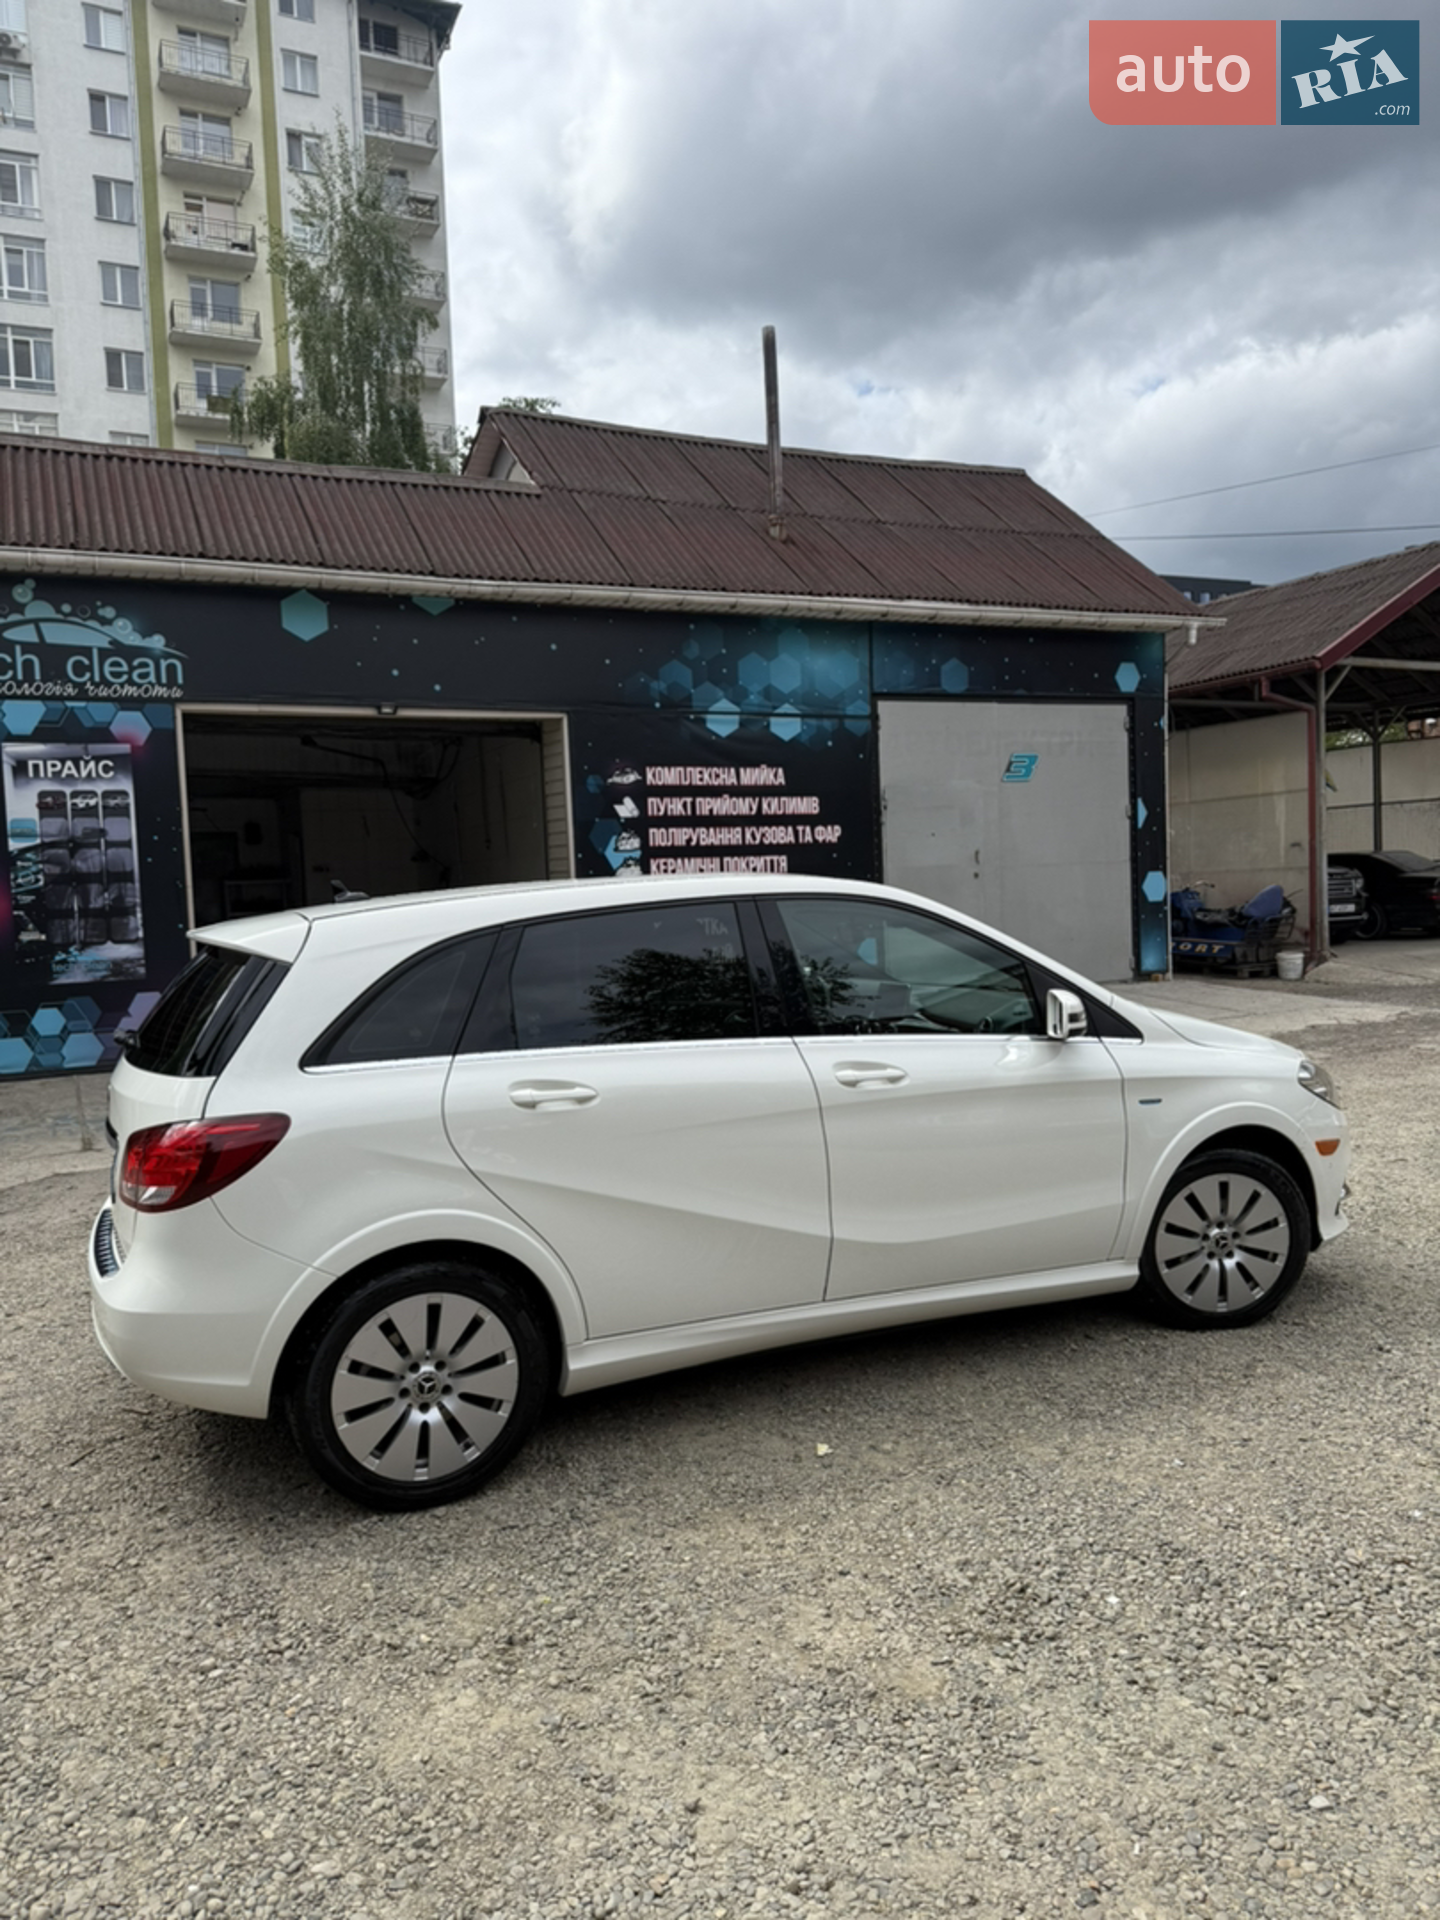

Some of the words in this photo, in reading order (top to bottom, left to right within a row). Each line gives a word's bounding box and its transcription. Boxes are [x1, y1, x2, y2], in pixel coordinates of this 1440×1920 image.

[66, 647, 184, 684] clean
[84, 682, 184, 698] чистоти
[27, 755, 115, 779] ПРАЙС
[646, 766, 738, 787] КОМПЛЕКСНА
[739, 764, 786, 787] МИЙКА
[647, 796, 693, 817] ПУНКТ
[694, 793, 760, 817] ПРИЙОМУ
[761, 796, 821, 816] КИЛИМІВ
[649, 827, 742, 847] ПОЛІРУВАННЯ
[744, 826, 796, 846] КУЗОВА
[796, 825, 814, 845] ТА
[814, 824, 843, 845] ФАР
[650, 857, 721, 876] КЕРАМІЧНІ
[722, 855, 789, 874] ПОКРИТТЯ
